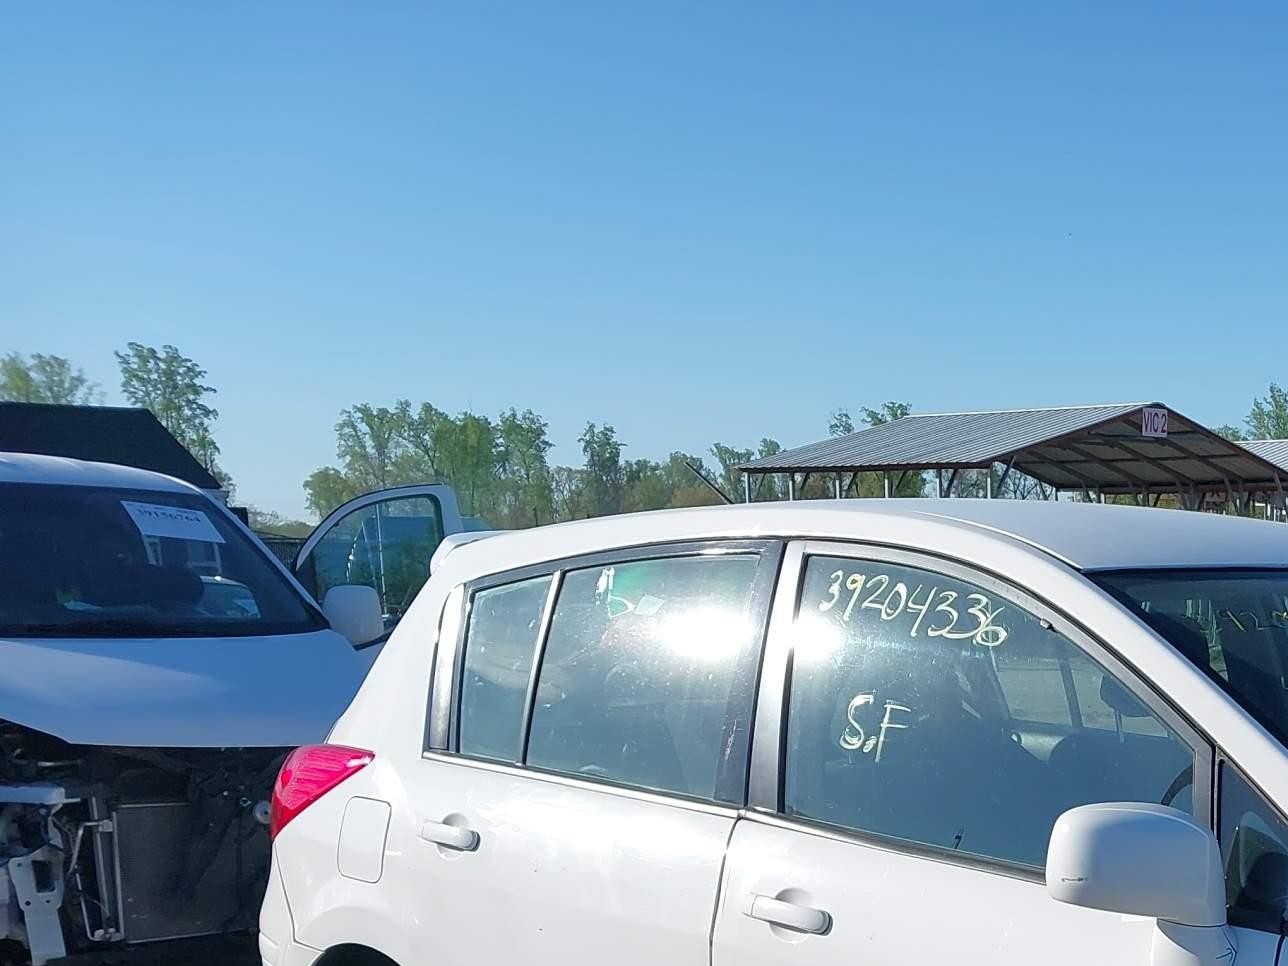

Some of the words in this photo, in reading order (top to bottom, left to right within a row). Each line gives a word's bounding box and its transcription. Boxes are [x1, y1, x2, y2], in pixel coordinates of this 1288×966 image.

[1143, 411, 1159, 433] VIC
[1161, 413, 1167, 433] 2
[819, 569, 1008, 647] 39204336
